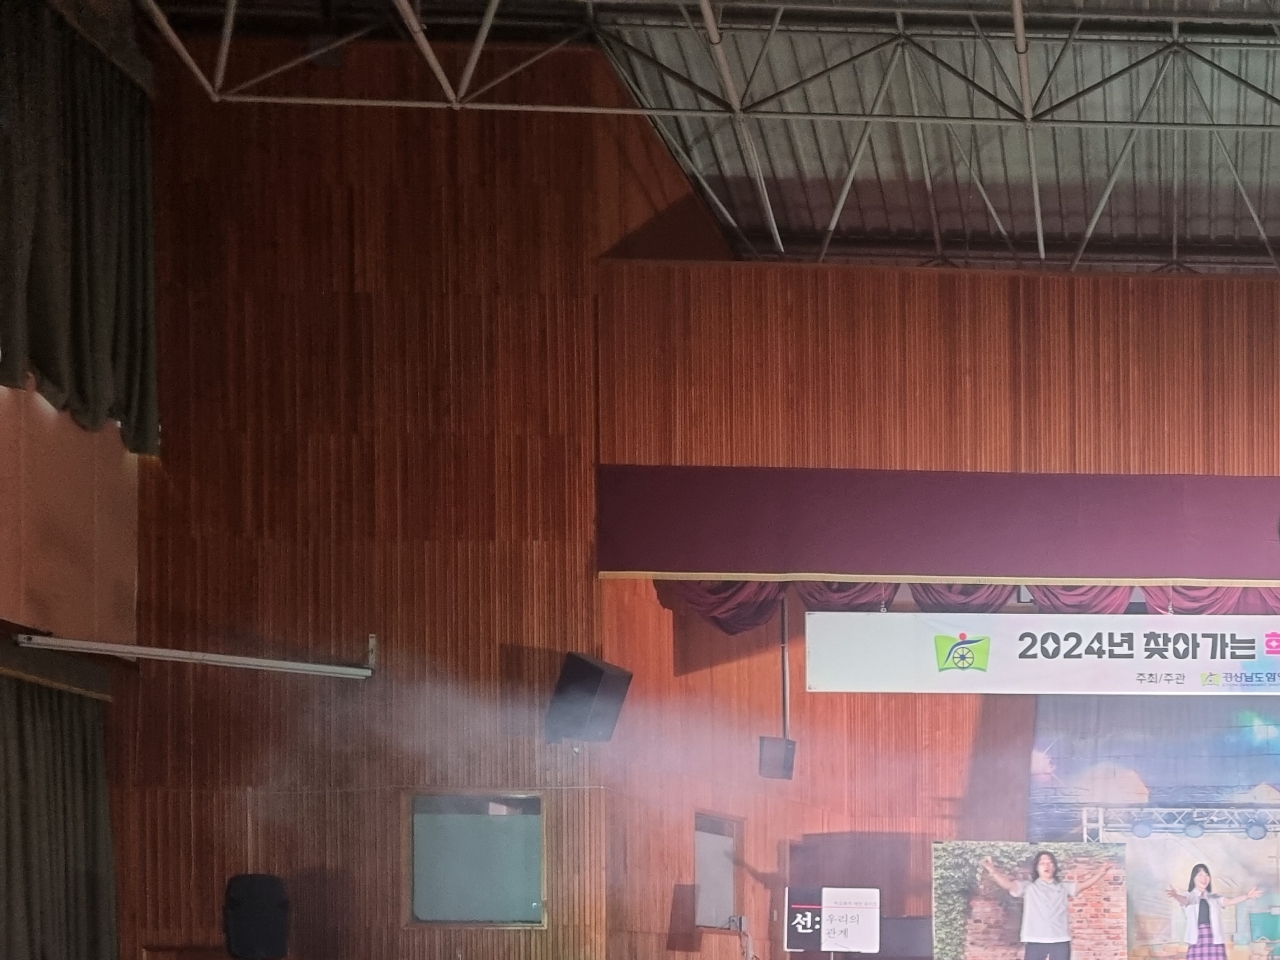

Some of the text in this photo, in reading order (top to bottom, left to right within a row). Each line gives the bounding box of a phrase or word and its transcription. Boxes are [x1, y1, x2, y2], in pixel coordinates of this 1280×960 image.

[1018, 631, 1135, 660] 2024년
[1143, 631, 1256, 660] 찾아가는
[1135, 672, 1186, 685] 주최/주관
[826, 913, 860, 925] 우리의
[826, 927, 849, 939] 관계
